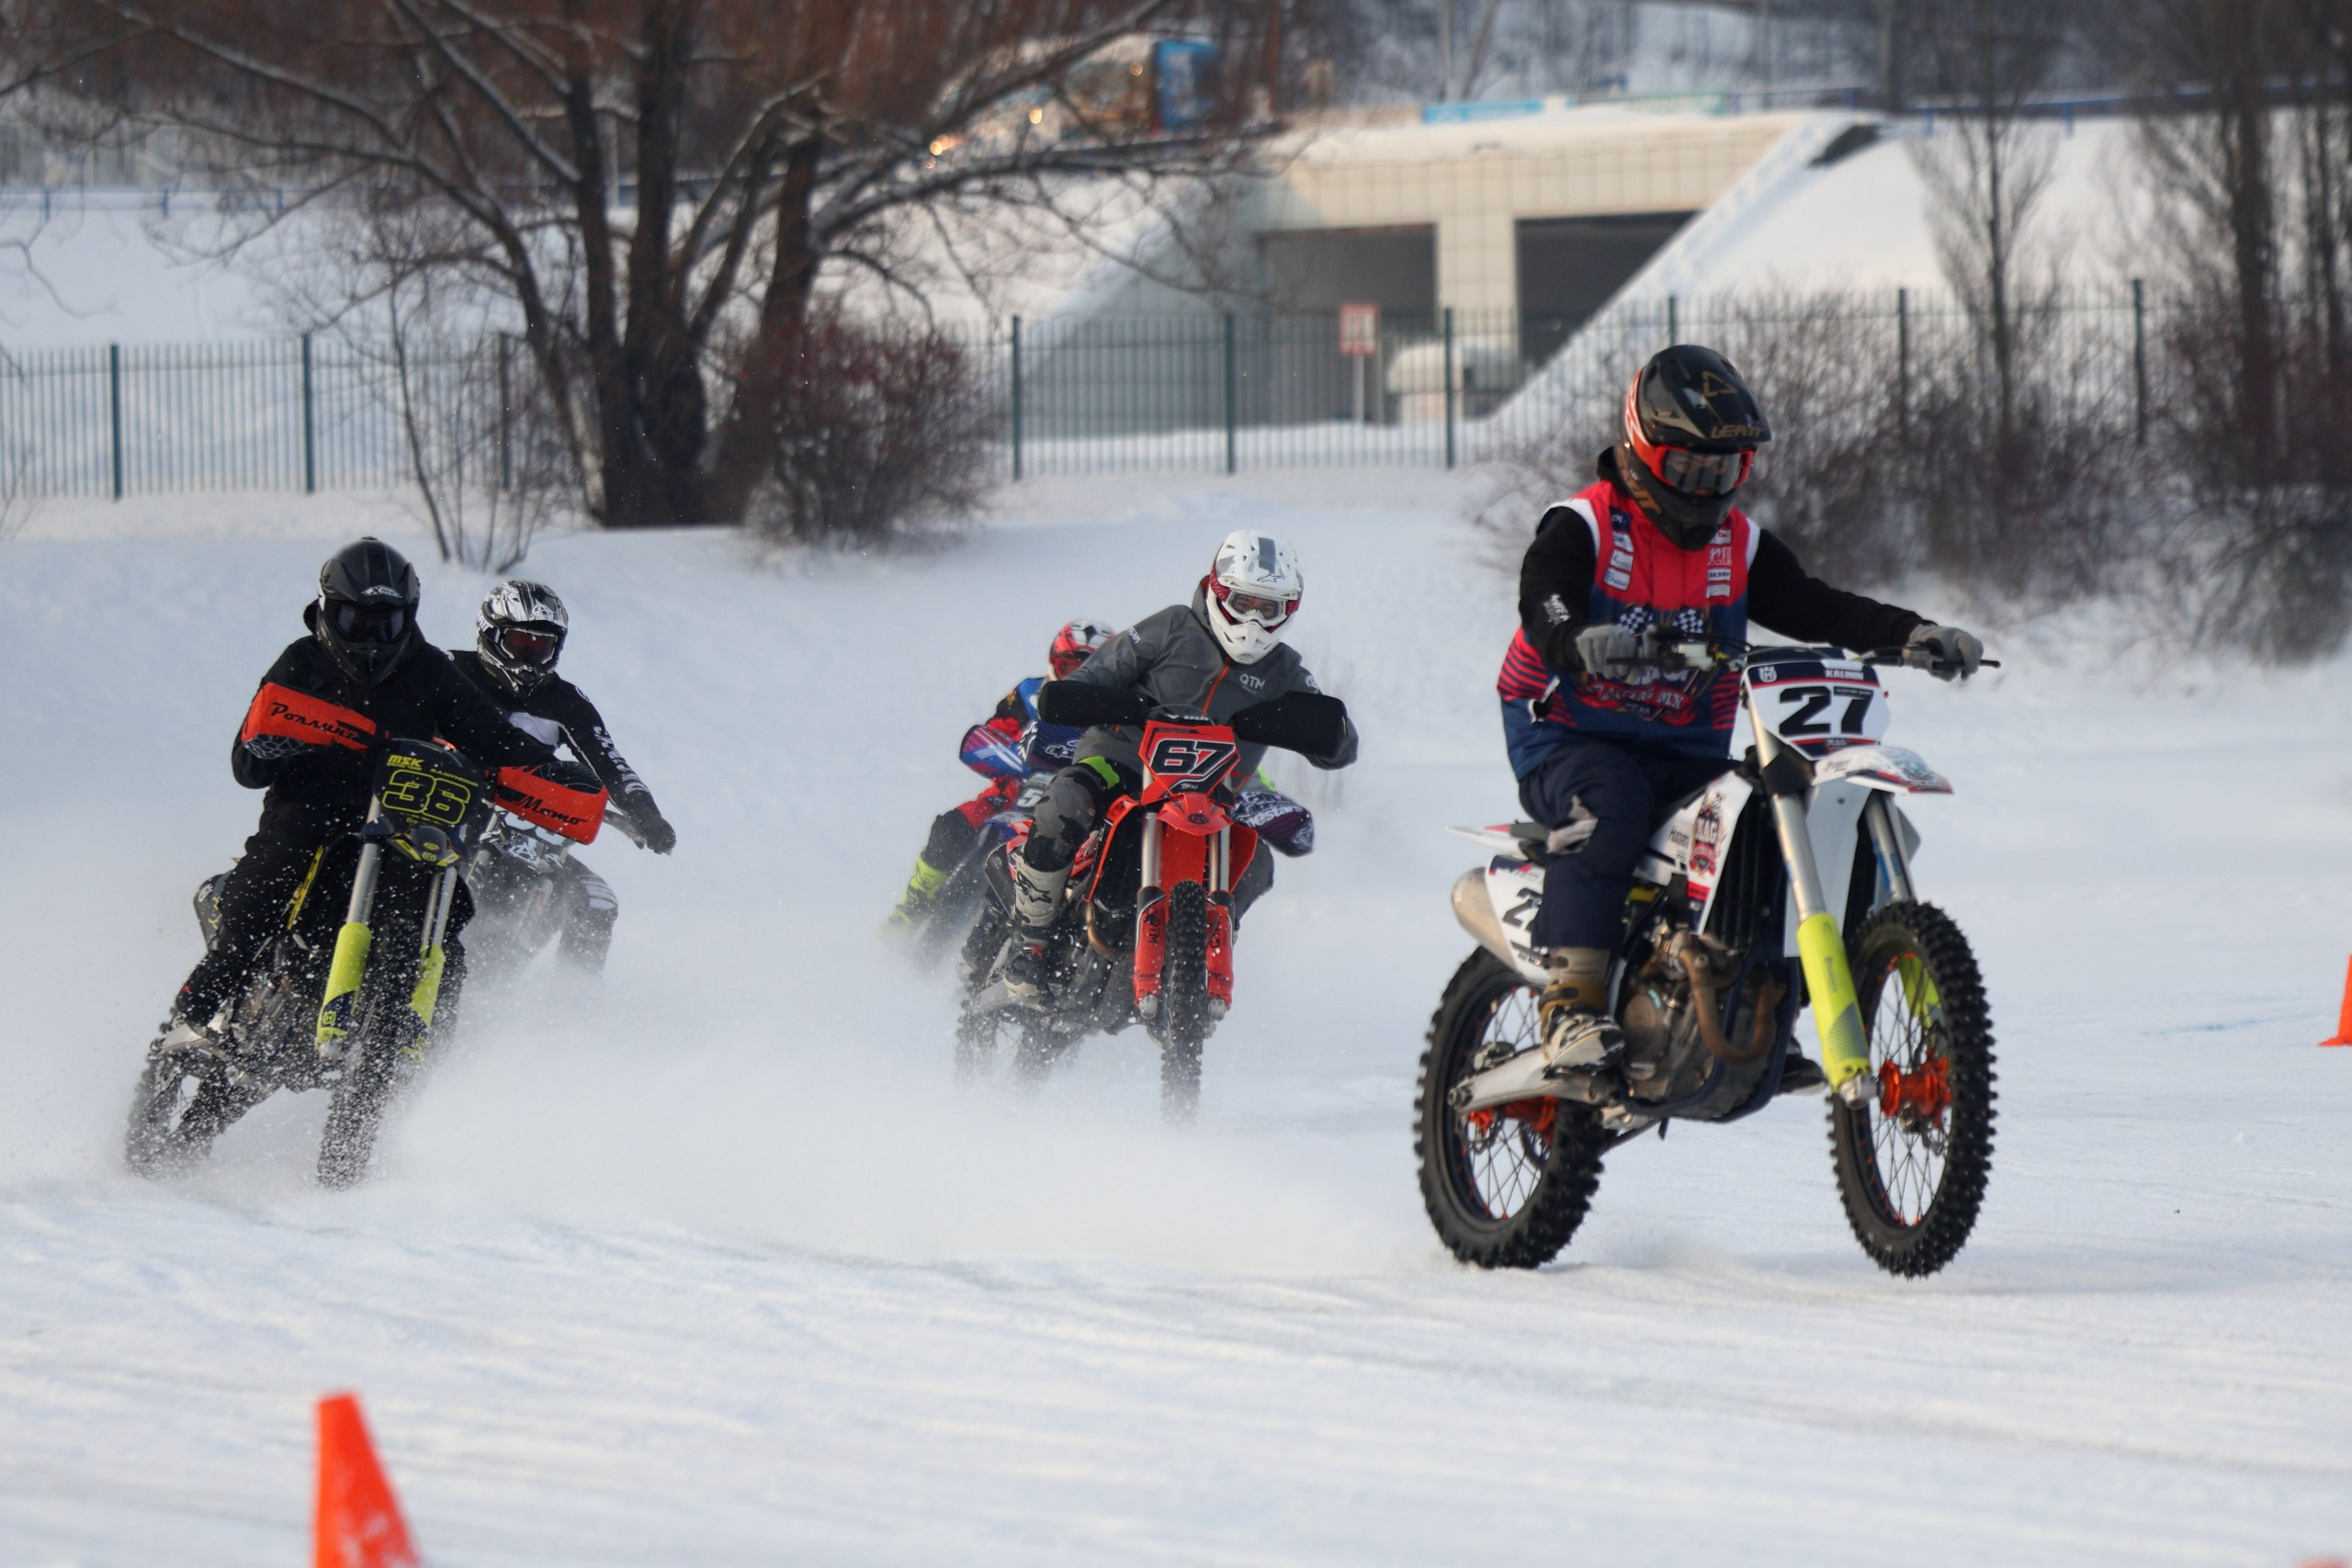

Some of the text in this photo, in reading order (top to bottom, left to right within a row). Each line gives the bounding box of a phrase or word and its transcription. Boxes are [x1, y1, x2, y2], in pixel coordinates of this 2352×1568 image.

[1710, 425, 1765, 439] LEATT
[1239, 673, 1267, 691] QTM
[1657, 690, 1685, 709] MX
[1779, 686, 1874, 737] 27
[387, 755, 424, 768] MSK
[1150, 739, 1236, 776] 67
[382, 769, 471, 825] 36
